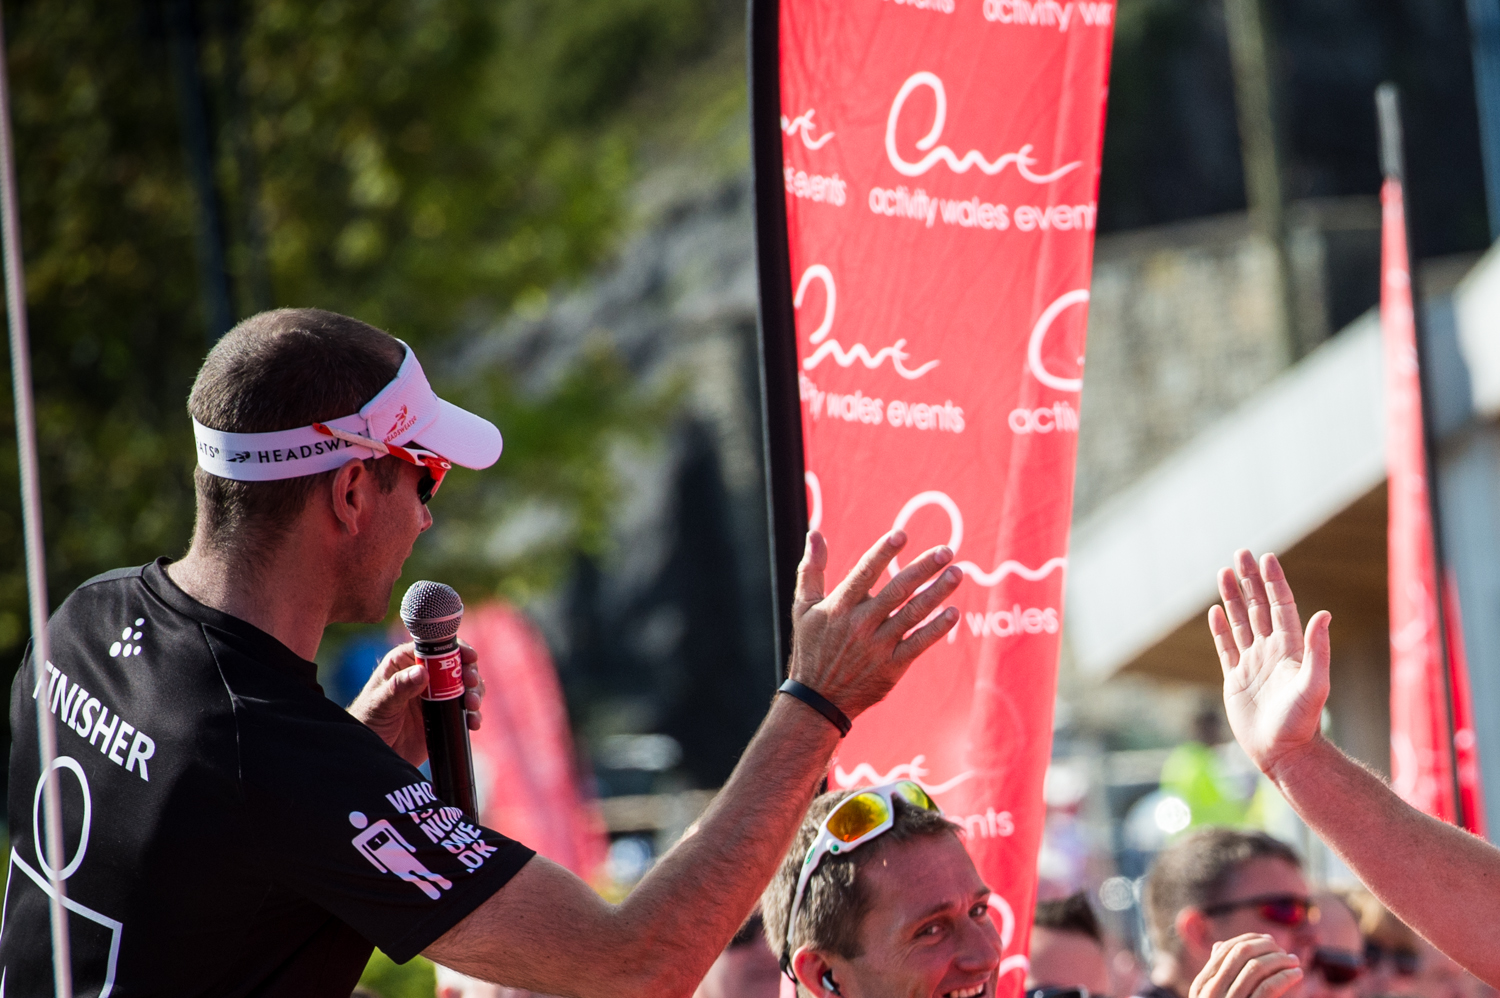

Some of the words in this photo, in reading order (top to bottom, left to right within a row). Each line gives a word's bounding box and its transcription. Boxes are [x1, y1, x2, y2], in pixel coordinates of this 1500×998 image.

[868, 184, 938, 229] activity
[939, 195, 1010, 231] wales
[826, 389, 883, 426] wales
[886, 399, 966, 435] events
[965, 603, 1060, 638] wales
[32, 660, 156, 782] FINISHER
[385, 782, 438, 814] WHO
[440, 821, 482, 854] ONE
